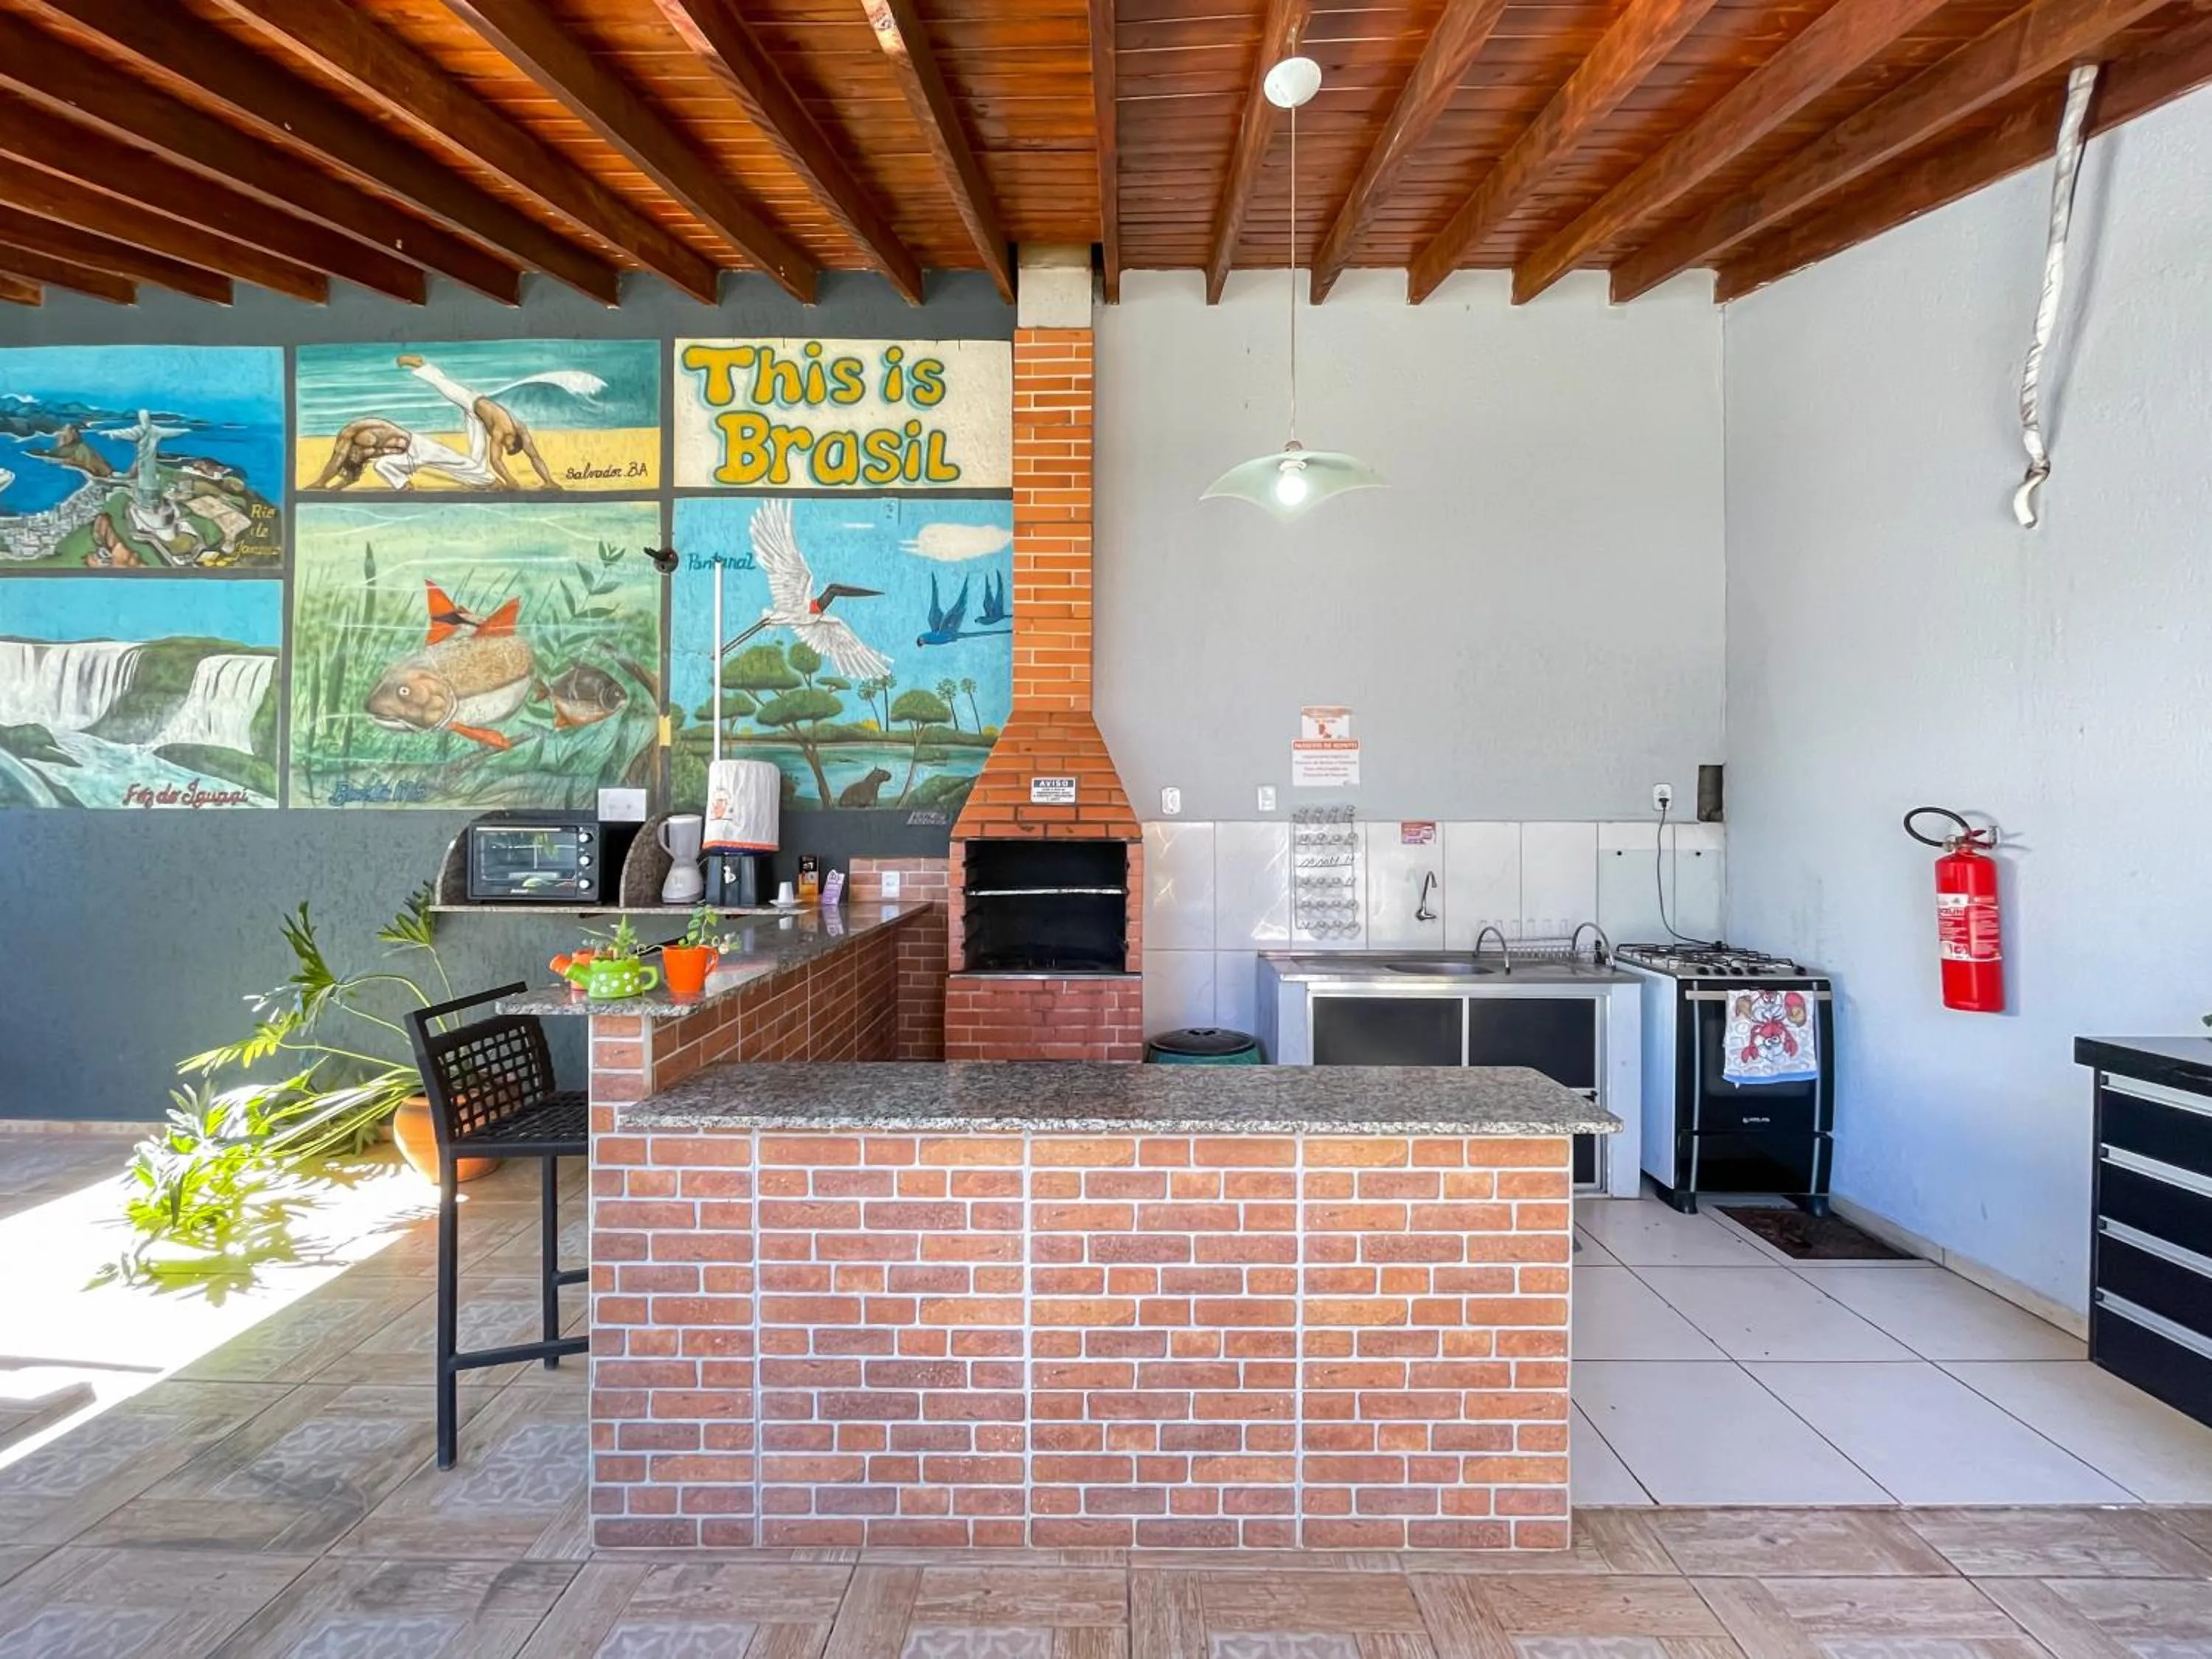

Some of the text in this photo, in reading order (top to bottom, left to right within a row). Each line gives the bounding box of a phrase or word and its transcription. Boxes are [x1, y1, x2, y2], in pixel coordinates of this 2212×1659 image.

[683, 341, 946, 406] This is
[1038, 779, 1069, 788] AVISO
